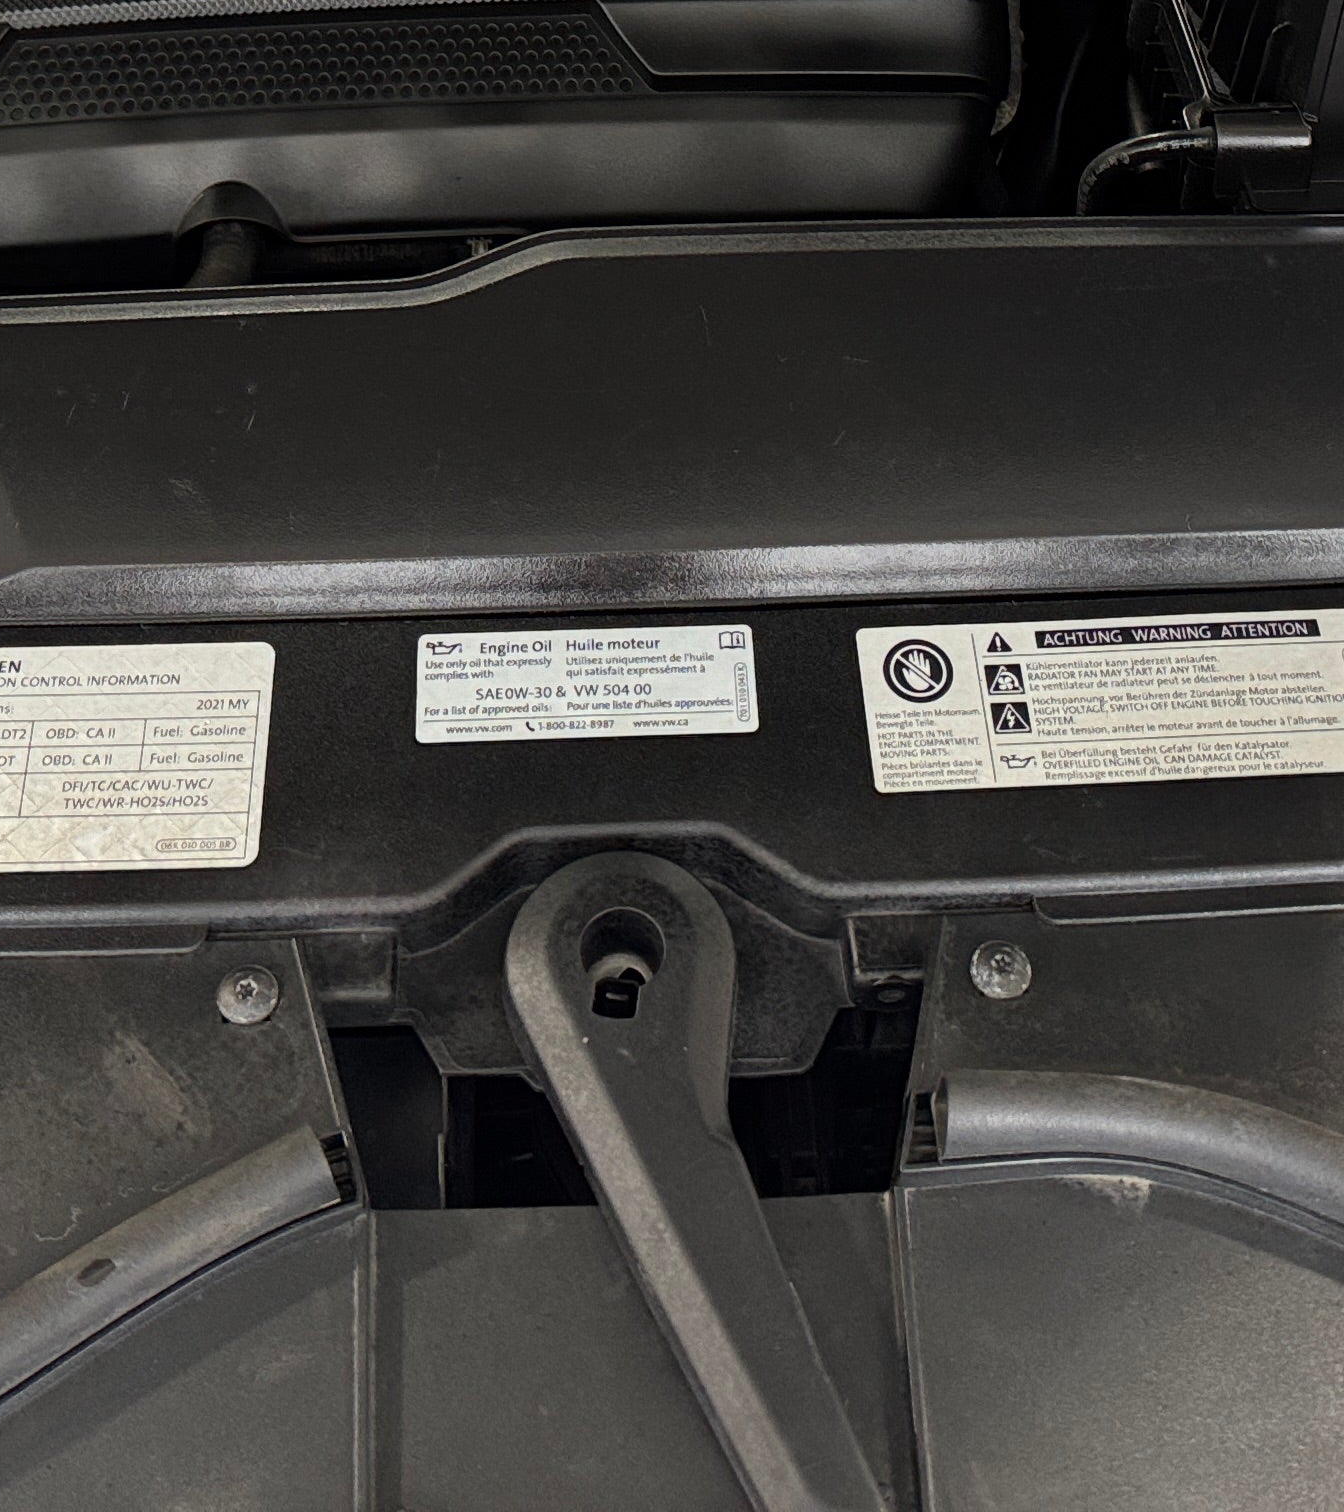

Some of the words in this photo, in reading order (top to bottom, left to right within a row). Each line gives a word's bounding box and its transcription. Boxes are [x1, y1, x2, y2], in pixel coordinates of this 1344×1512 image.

[1043, 629, 1123, 646] ACHTUNG
[1130, 625, 1212, 642] WARNING
[1220, 621, 1309, 638] ATTENTION
[480, 641, 528, 656] Engine
[532, 640, 552, 652] Oil
[566, 638, 603, 652] Huile
[607, 638, 661, 651] moteur
[425, 660, 443, 670] Use
[446, 659, 467, 670] only
[469, 658, 481, 668] oil
[483, 658, 504, 668] that
[506, 656, 553, 669] expressly
[606, 654, 667, 666] uniquement
[669, 653, 682, 663] de
[424, 670, 469, 682] complies
[471, 669, 494, 679] with
[566, 668, 582, 679] qui
[584, 665, 624, 676] satisfait
[626, 664, 697, 677] expressément
[699, 663, 706, 674] à
[1027, 671, 1076, 682] RADIATOR
[1077, 670, 1098, 679] FAN
[1099, 668, 1123, 678] MAY
[1125, 667, 1154, 677] START
[1156, 666, 1168, 675] AT
[1170, 665, 1190, 675] ANY
[21, 675, 82, 688] CONTROL
[87, 674, 181, 687] INFORMATION
[556, 686, 567, 698] &
[574, 684, 599, 697] VW
[602, 683, 630, 696] 504
[633, 683, 652, 696] 00
[196, 699, 225, 710] 2021
[228, 699, 250, 710] MY
[424, 707, 440, 717] For
[442, 709, 449, 717] a
[452, 706, 467, 716] list
[469, 705, 481, 715] of
[482, 703, 530, 717] approved
[567, 701, 590, 712] Pour
[592, 702, 610, 711] une
[612, 700, 633, 710] liste
[86, 727, 105, 738] CA
[190, 724, 246, 736] Gasoline
[446, 724, 512, 734] www.vw.com
[633, 718, 689, 729] www.vw.ca
[82, 754, 101, 765] CA
[187, 751, 244, 764] Gasoline
[1043, 758, 1102, 770] OVERFILLED
[1104, 756, 1141, 768] ENGINE
[1164, 753, 1186, 764] CAN
[1188, 751, 1233, 763] DAMAGE
